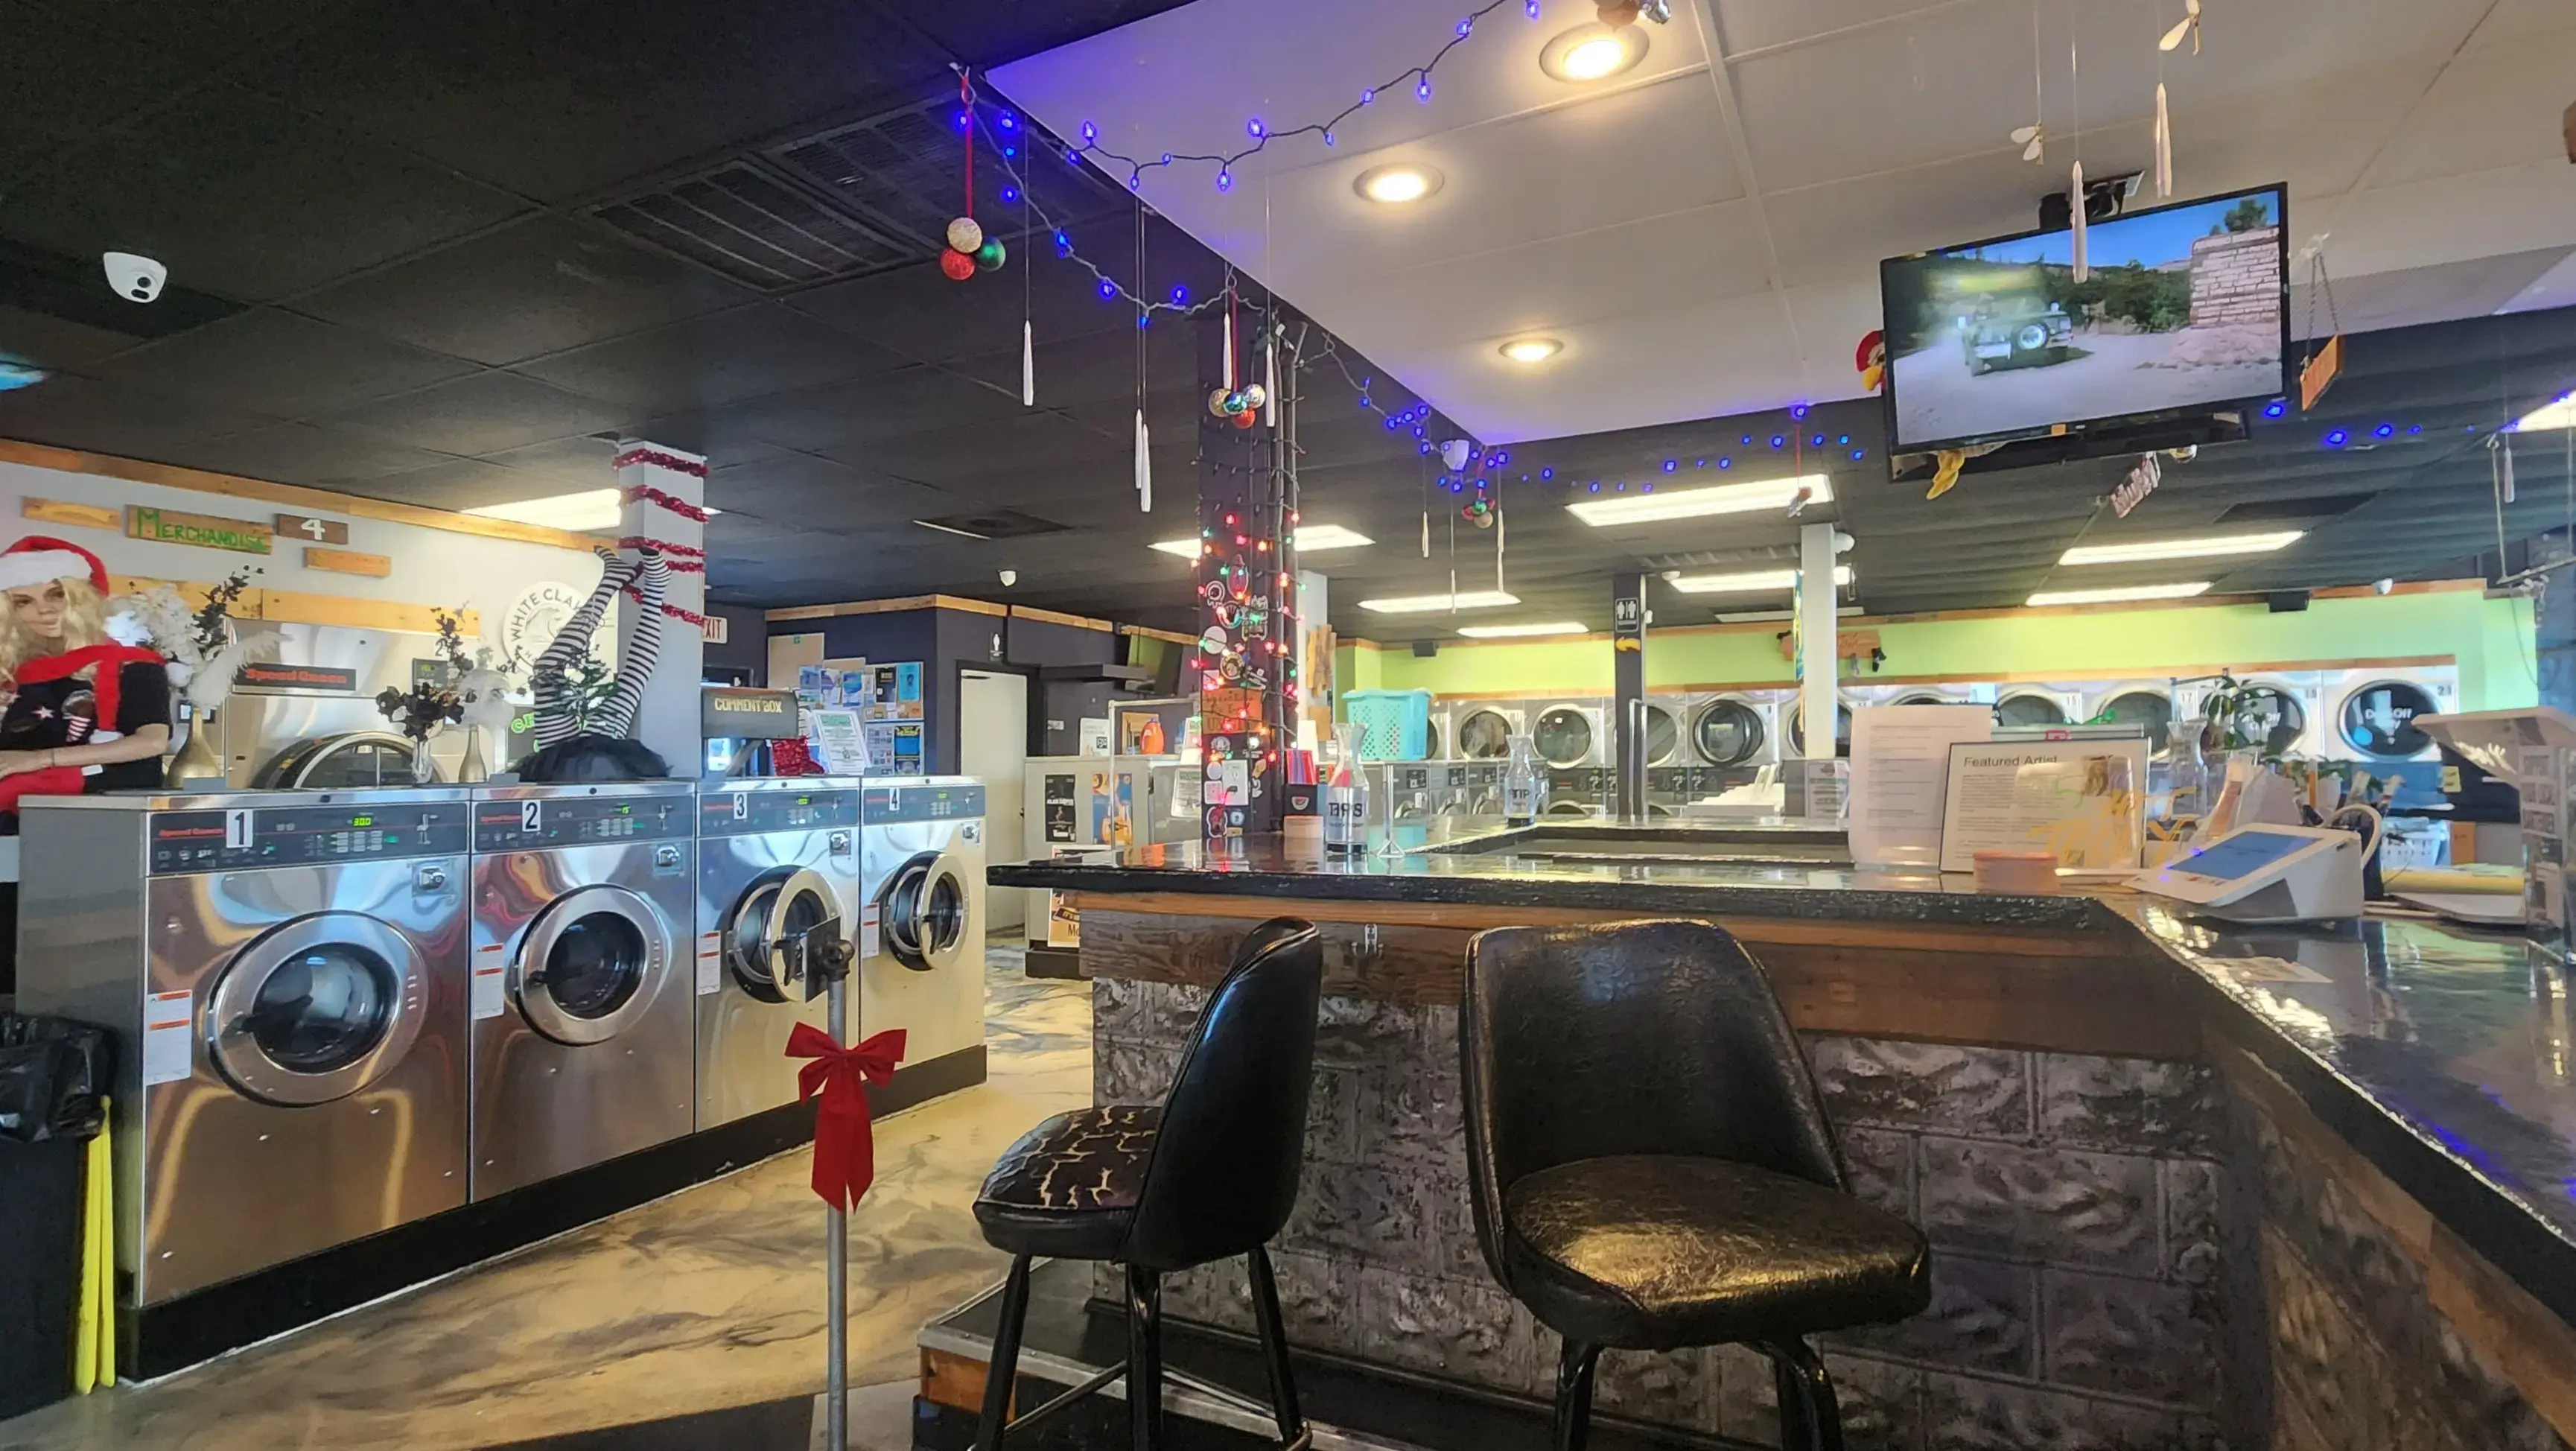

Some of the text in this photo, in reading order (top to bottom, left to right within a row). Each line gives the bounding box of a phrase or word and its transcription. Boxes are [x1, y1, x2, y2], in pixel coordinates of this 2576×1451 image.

[301, 518, 325, 540] 4
[510, 592, 541, 642] WHITE
[703, 619, 722, 639] XIT
[714, 697, 783, 713] COMMENT BOX
[1964, 755, 2058, 767] Featured Artist
[736, 794, 745, 816] 3
[891, 788, 898, 805] 4
[525, 801, 538, 829] 2
[235, 811, 245, 845] 1
